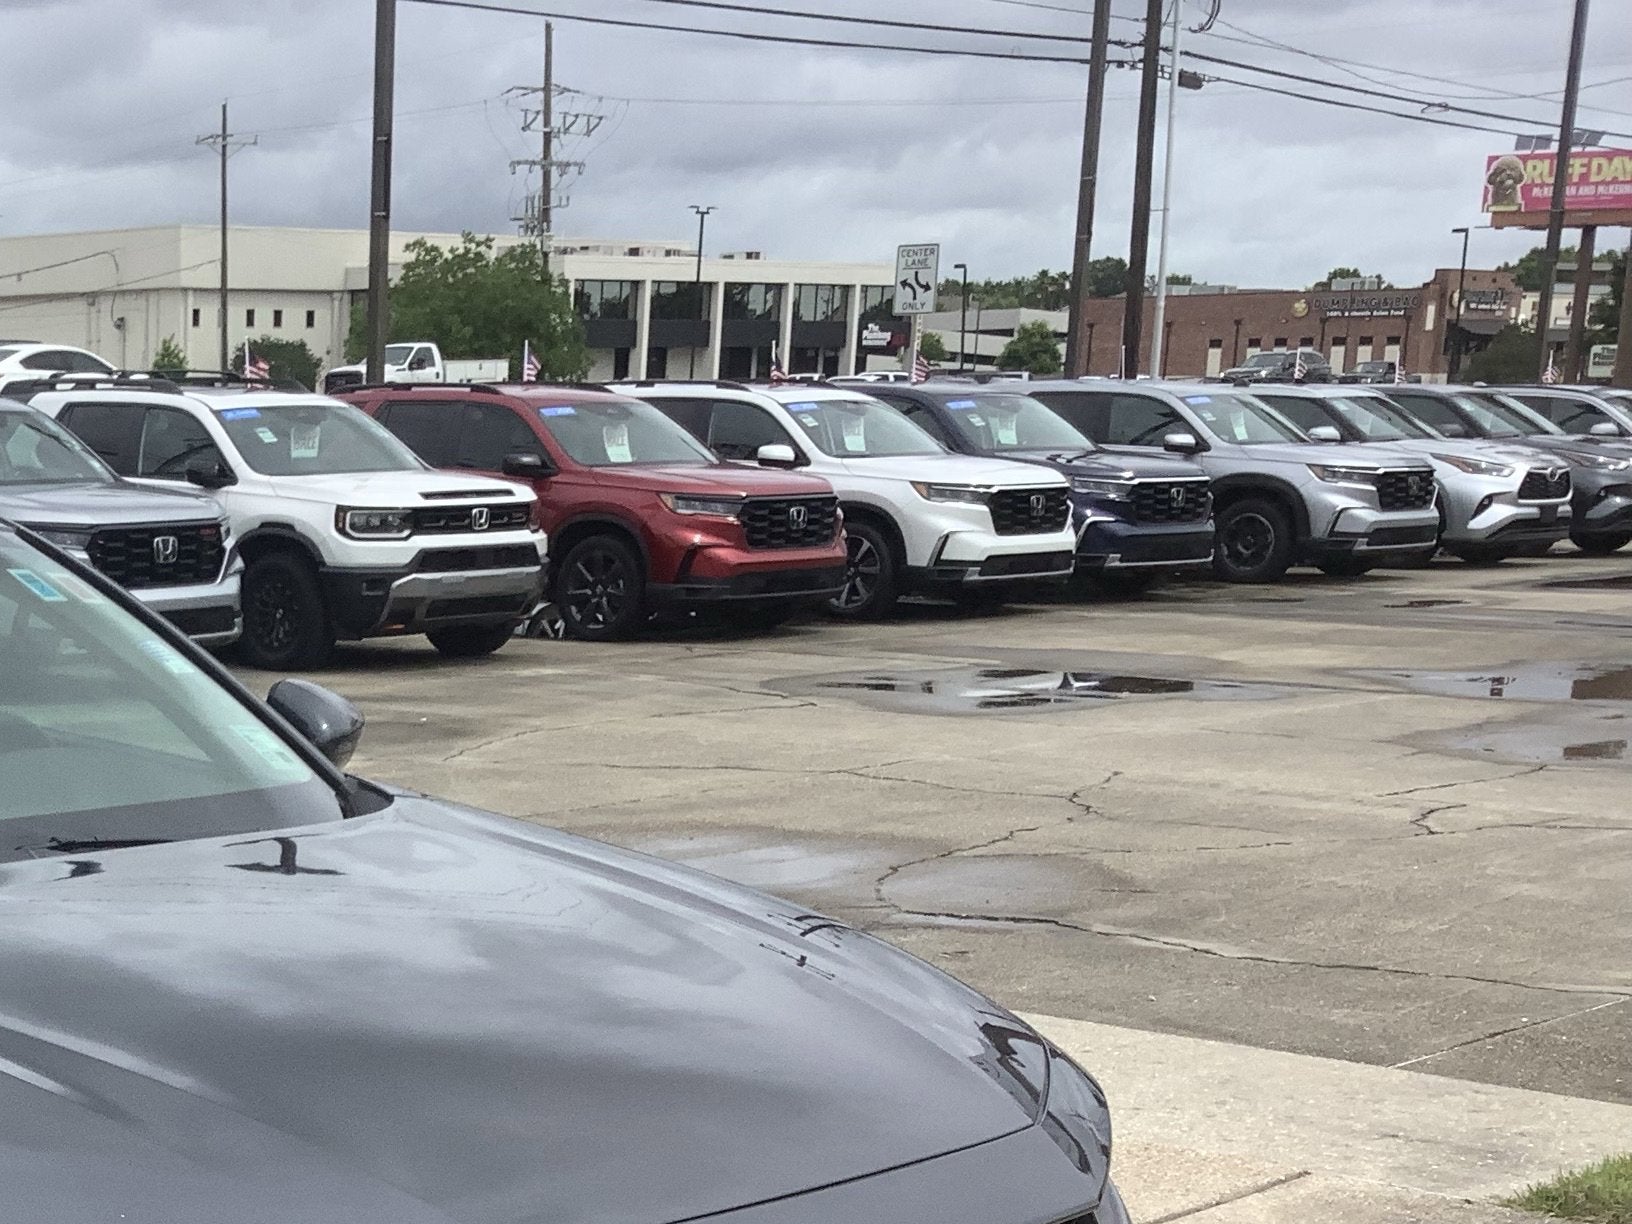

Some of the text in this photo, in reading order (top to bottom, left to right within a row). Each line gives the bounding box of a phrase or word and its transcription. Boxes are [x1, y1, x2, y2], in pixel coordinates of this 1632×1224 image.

[1525, 156, 1588, 184] RUF
[901, 247, 936, 258] CENTER
[905, 257, 929, 267] LANE
[902, 301, 926, 310] ONLY
